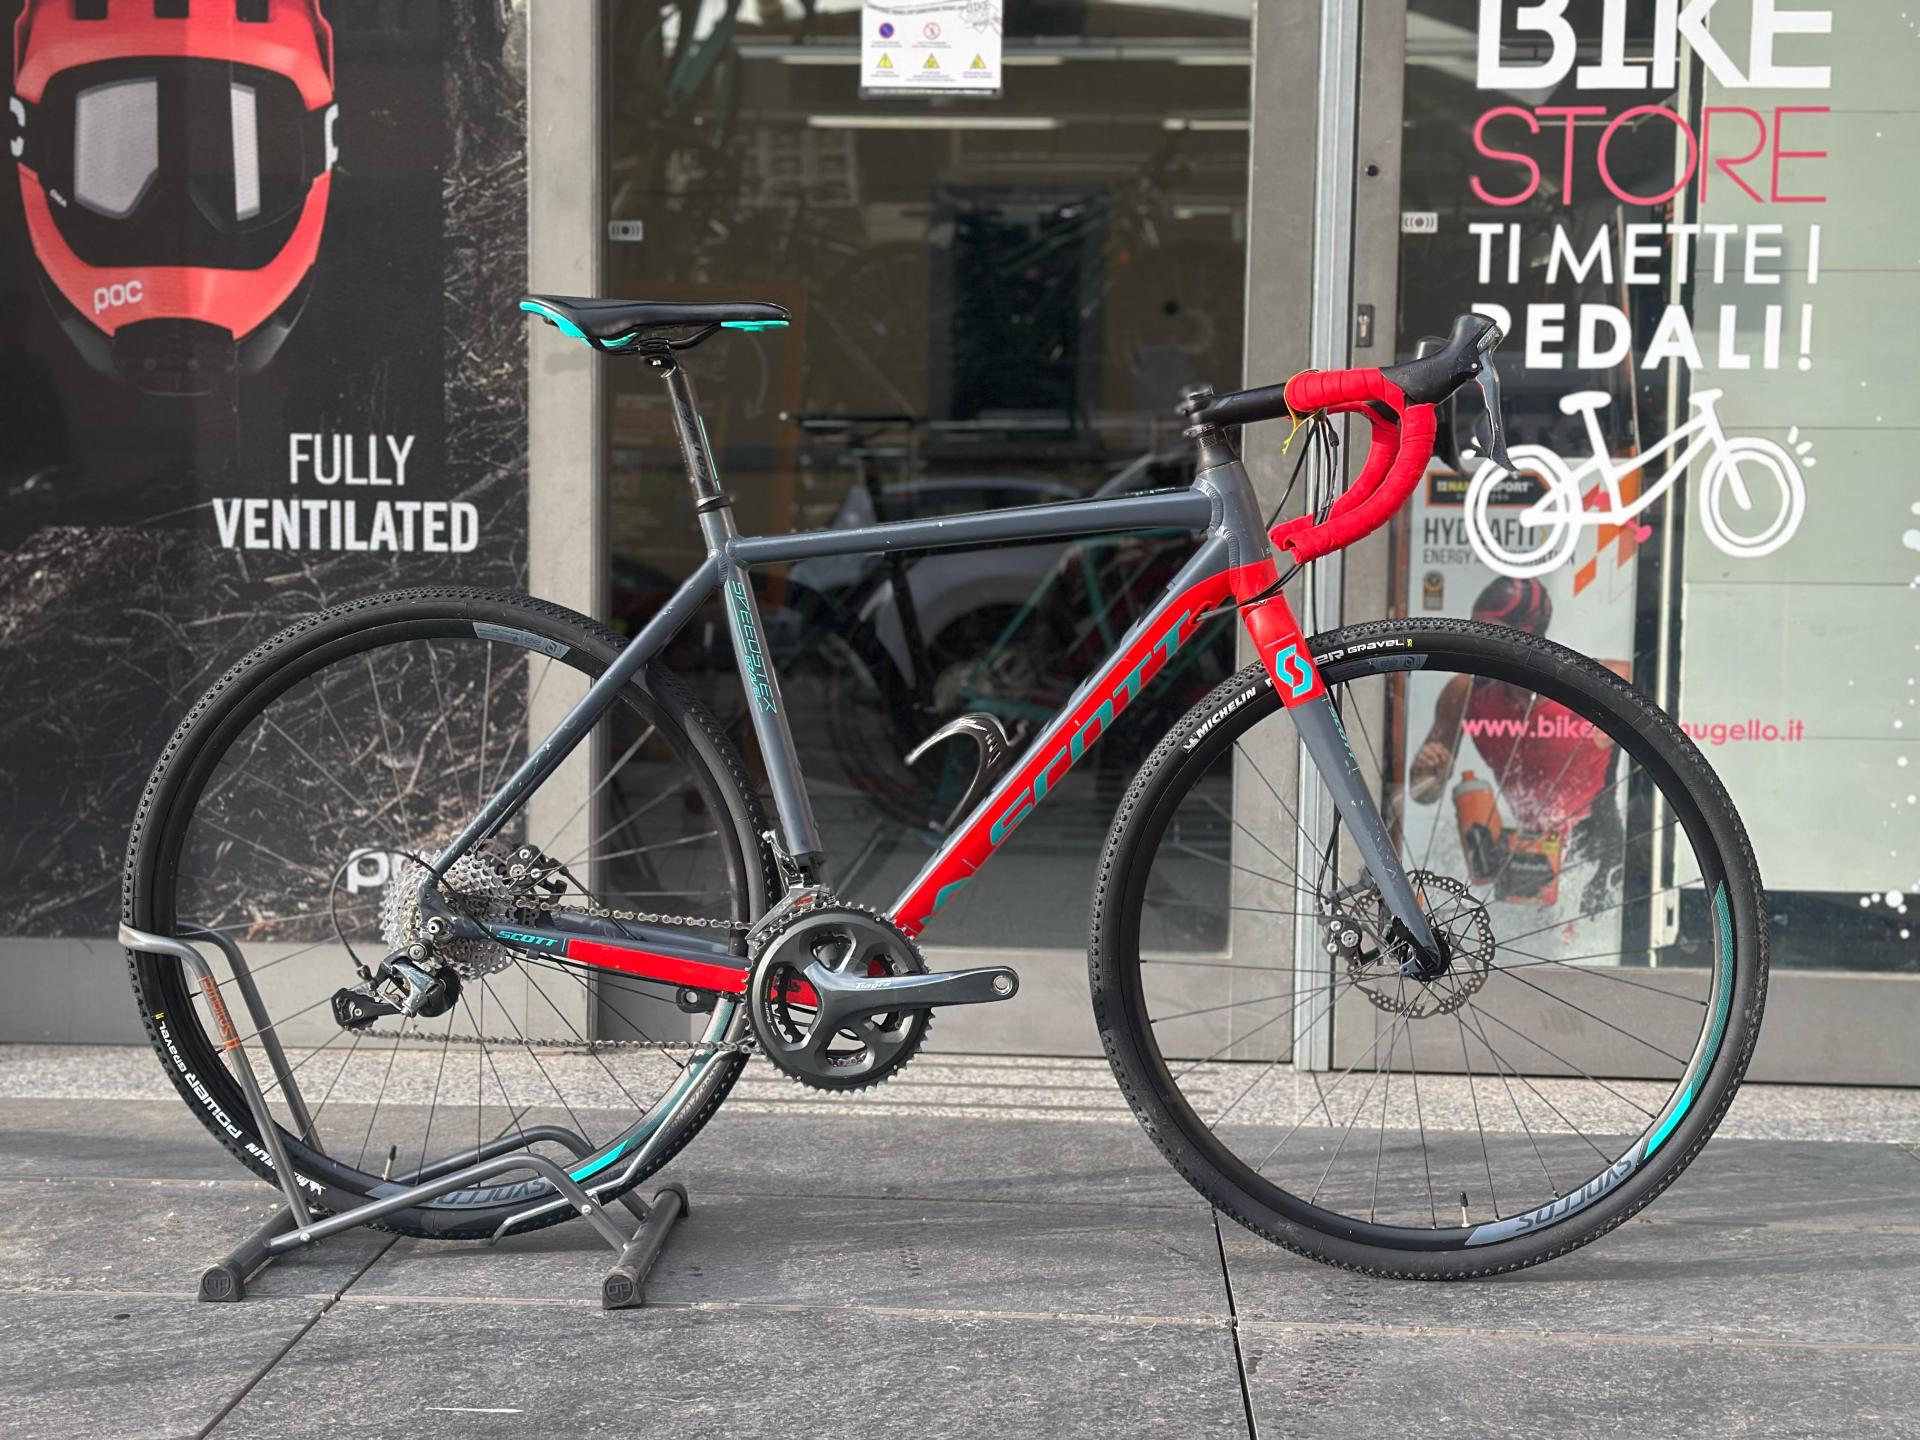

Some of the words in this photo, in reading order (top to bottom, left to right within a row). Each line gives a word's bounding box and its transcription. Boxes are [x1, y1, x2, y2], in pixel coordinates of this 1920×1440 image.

[1477, 0, 1832, 89] BIKE
[1469, 105, 1831, 206] STORE
[1468, 223, 1521, 284] TI
[1546, 223, 1783, 284] METTE
[289, 433, 416, 486] FULLY
[212, 497, 479, 553] VENTILATED
[1197, 687, 1257, 739] MICHELIN
[497, 930, 558, 947] SCOTT
